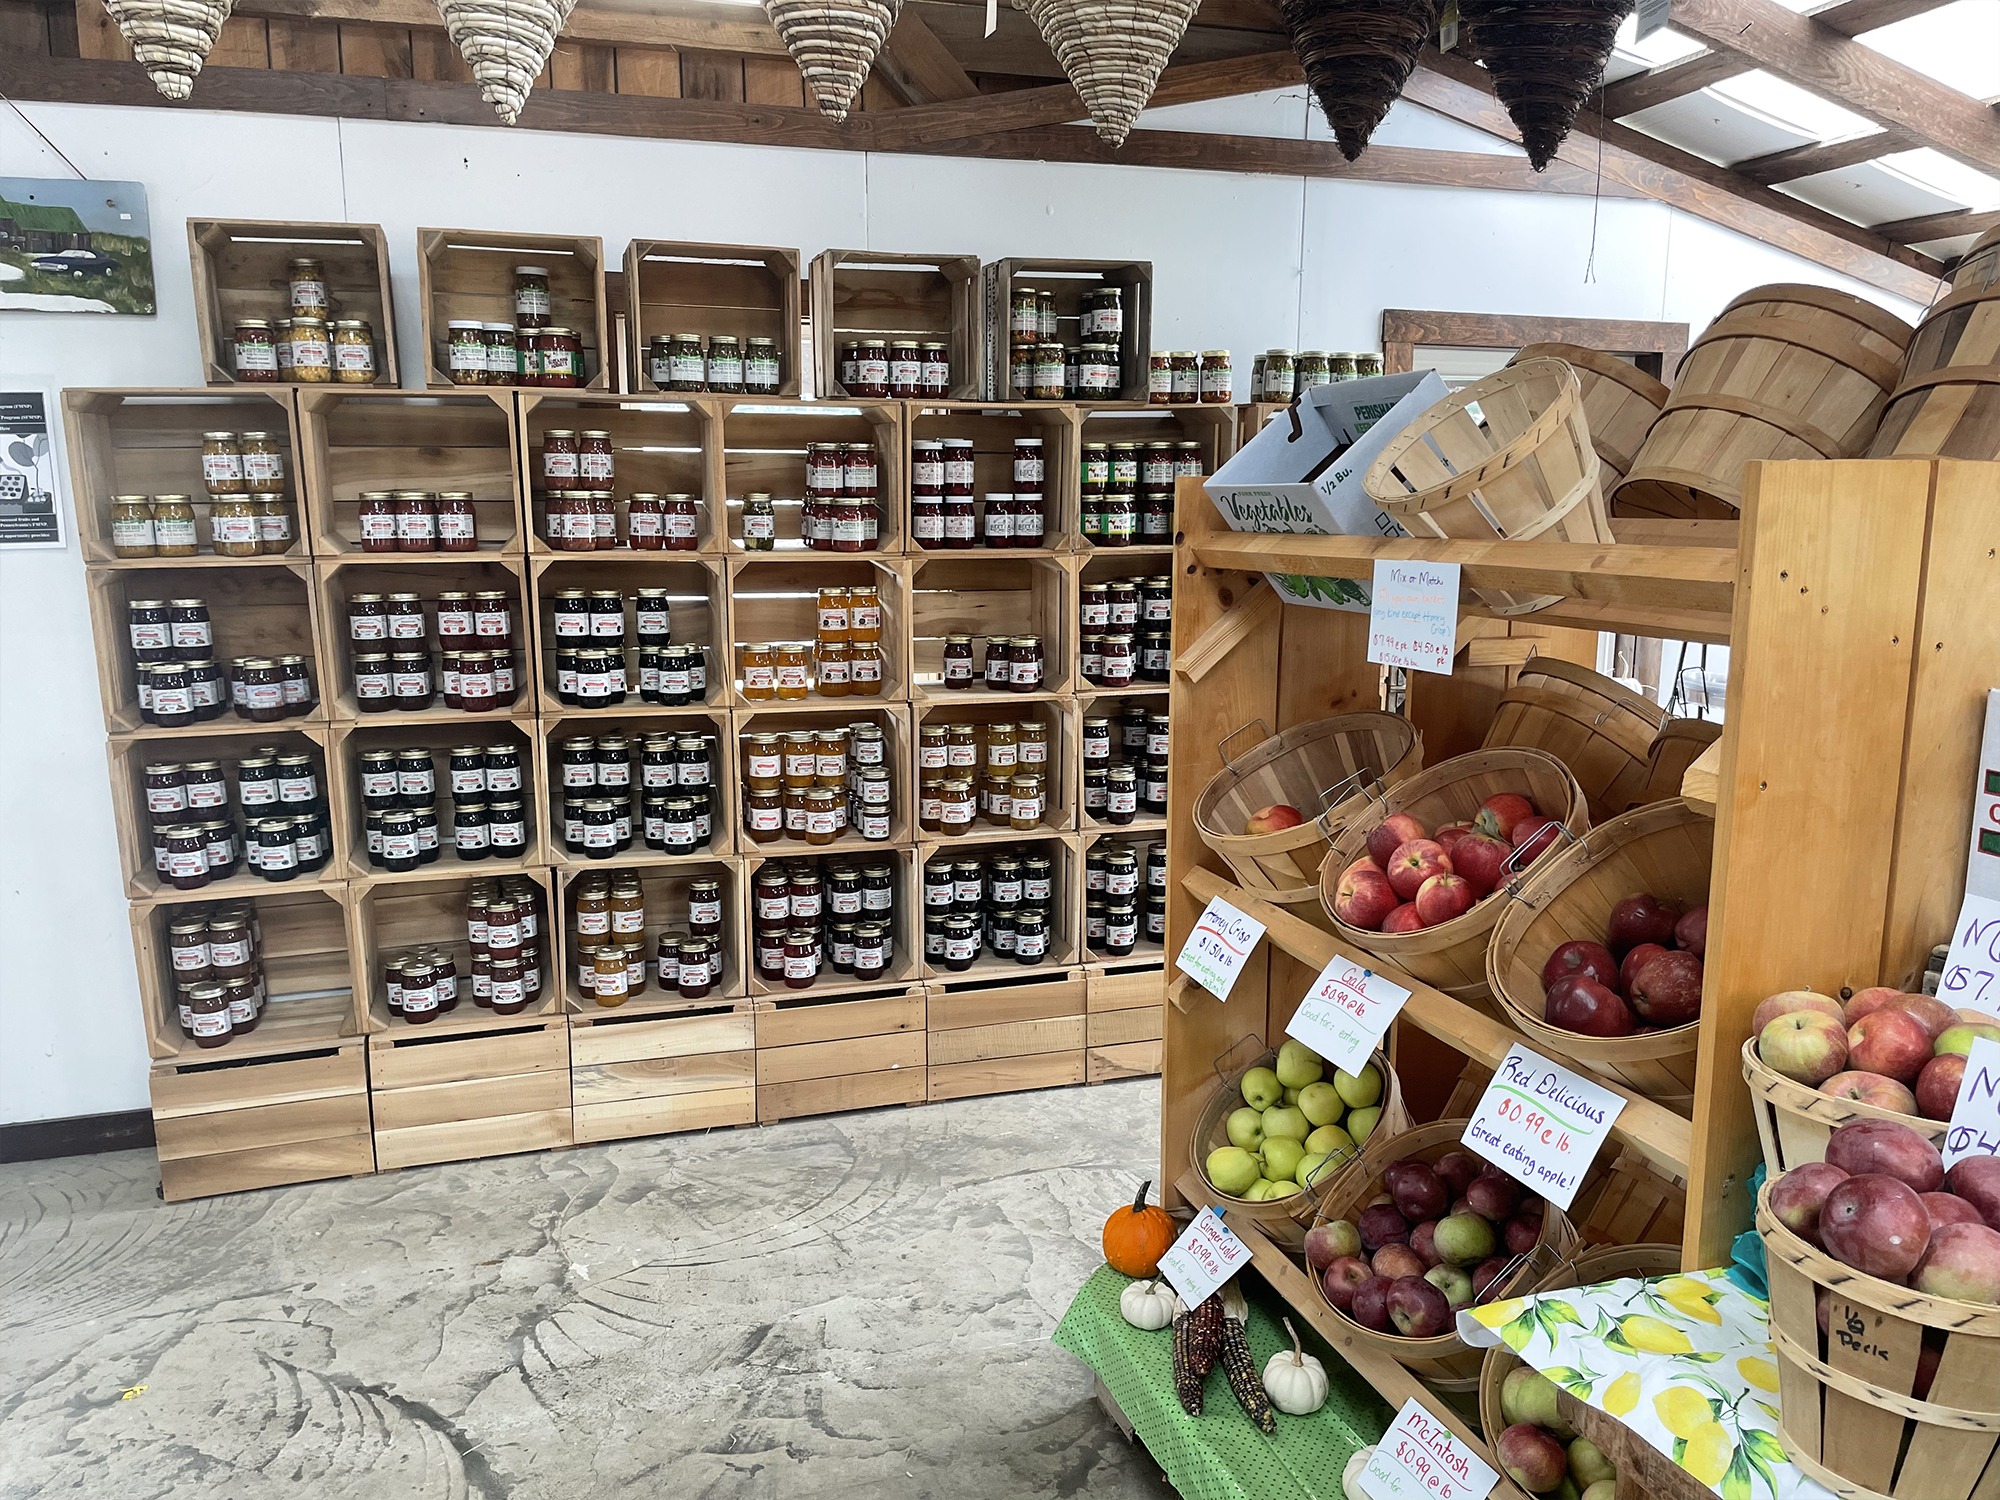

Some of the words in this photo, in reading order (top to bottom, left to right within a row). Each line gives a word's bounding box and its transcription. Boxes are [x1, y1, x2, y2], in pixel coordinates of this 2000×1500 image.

[1321, 481, 1337, 495] 1/2
[1335, 468, 1353, 483] Bu.
[1220, 492, 1313, 531] Vegetables
[1390, 569, 1406, 583] Mix
[1204, 906, 1229, 936] Honey
[1229, 918, 1251, 944] Crisp
[1321, 984, 1349, 1005] $0.99
[1341, 967, 1367, 994] Gala
[1301, 1002, 1320, 1022] Good
[1338, 1030, 1360, 1054] eating
[1501, 1055, 1538, 1088] Red
[1533, 1073, 1606, 1125] Delicious
[1471, 1117, 1503, 1148] Great
[1502, 1144, 1536, 1177] eating
[1537, 1165, 1576, 1191] apple!
[1200, 1214, 1223, 1242] Ginger
[1219, 1237, 1242, 1261] Gold
[1368, 1458, 1392, 1483] Good
[1396, 1440, 1431, 1482] $0.99
